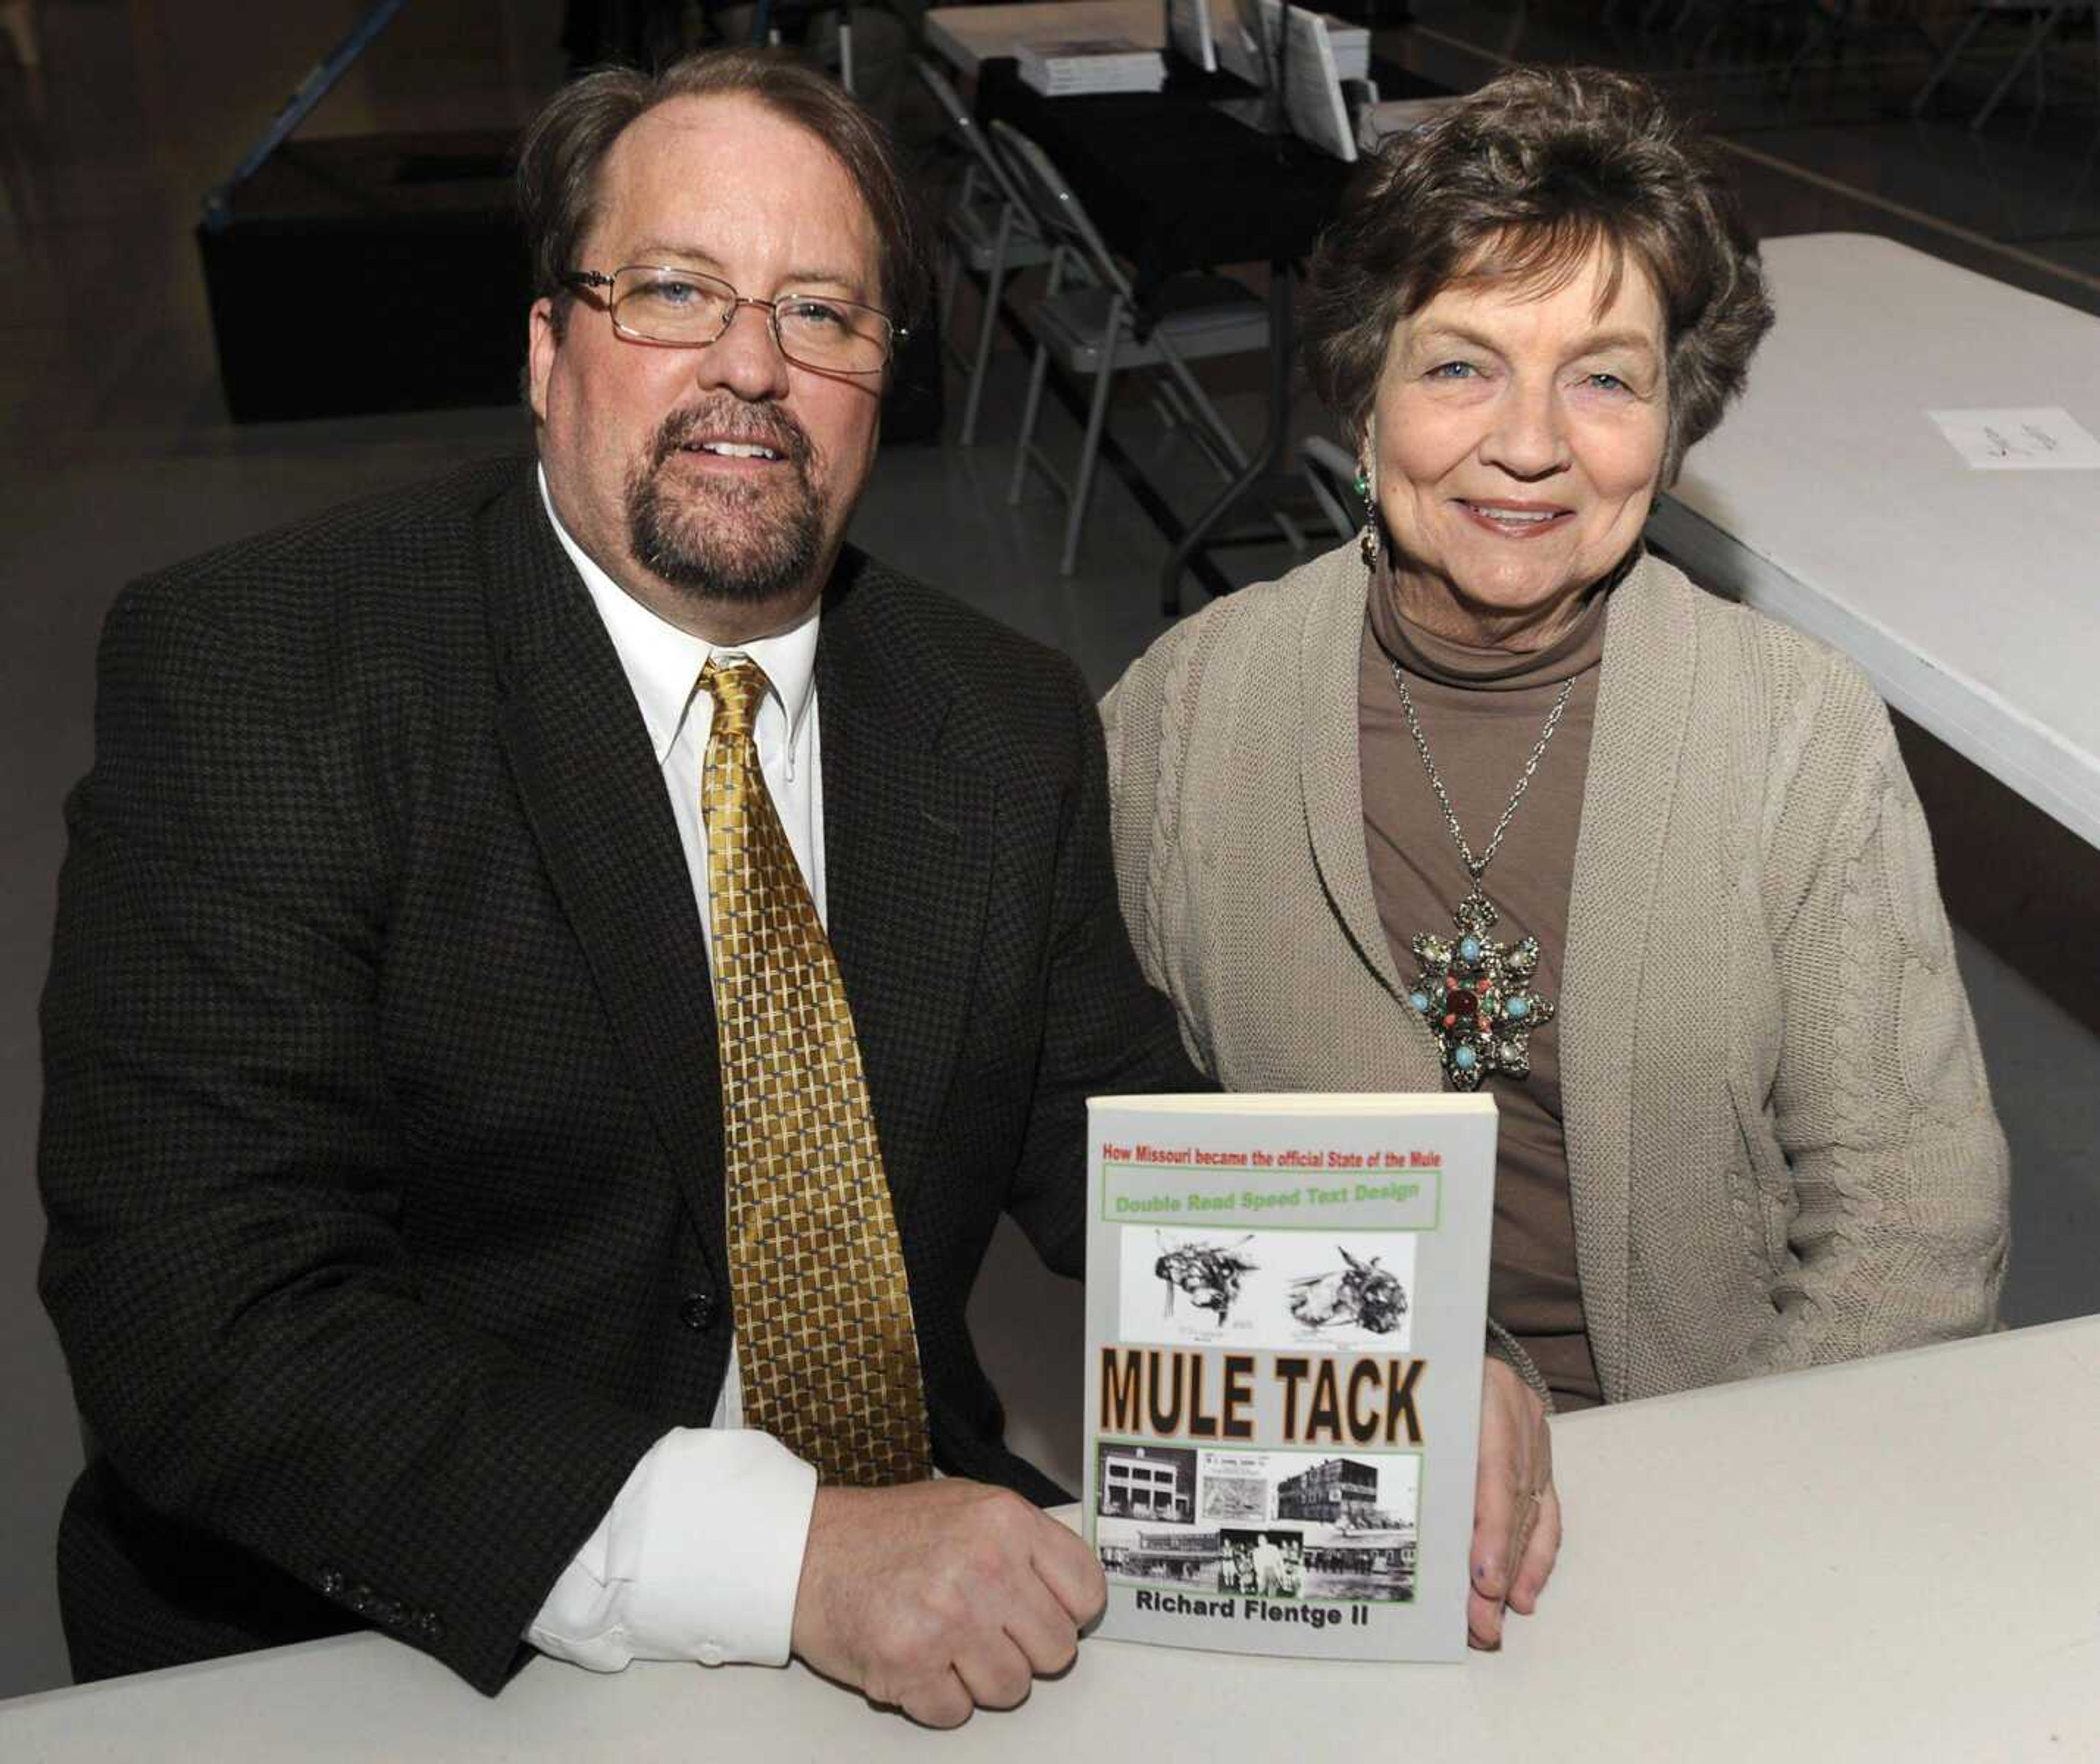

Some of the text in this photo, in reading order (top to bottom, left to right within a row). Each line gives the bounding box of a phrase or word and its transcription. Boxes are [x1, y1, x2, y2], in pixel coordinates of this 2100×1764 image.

[1103, 1144, 1442, 1168] How Missouri became the official State of the Mule
[1116, 1184, 1420, 1212] Double Read Speed Text Design
[1099, 1348, 1427, 1447] MULE TACK
[1136, 1591, 1236, 1619] Richard
[1351, 1605, 1368, 1625] II
